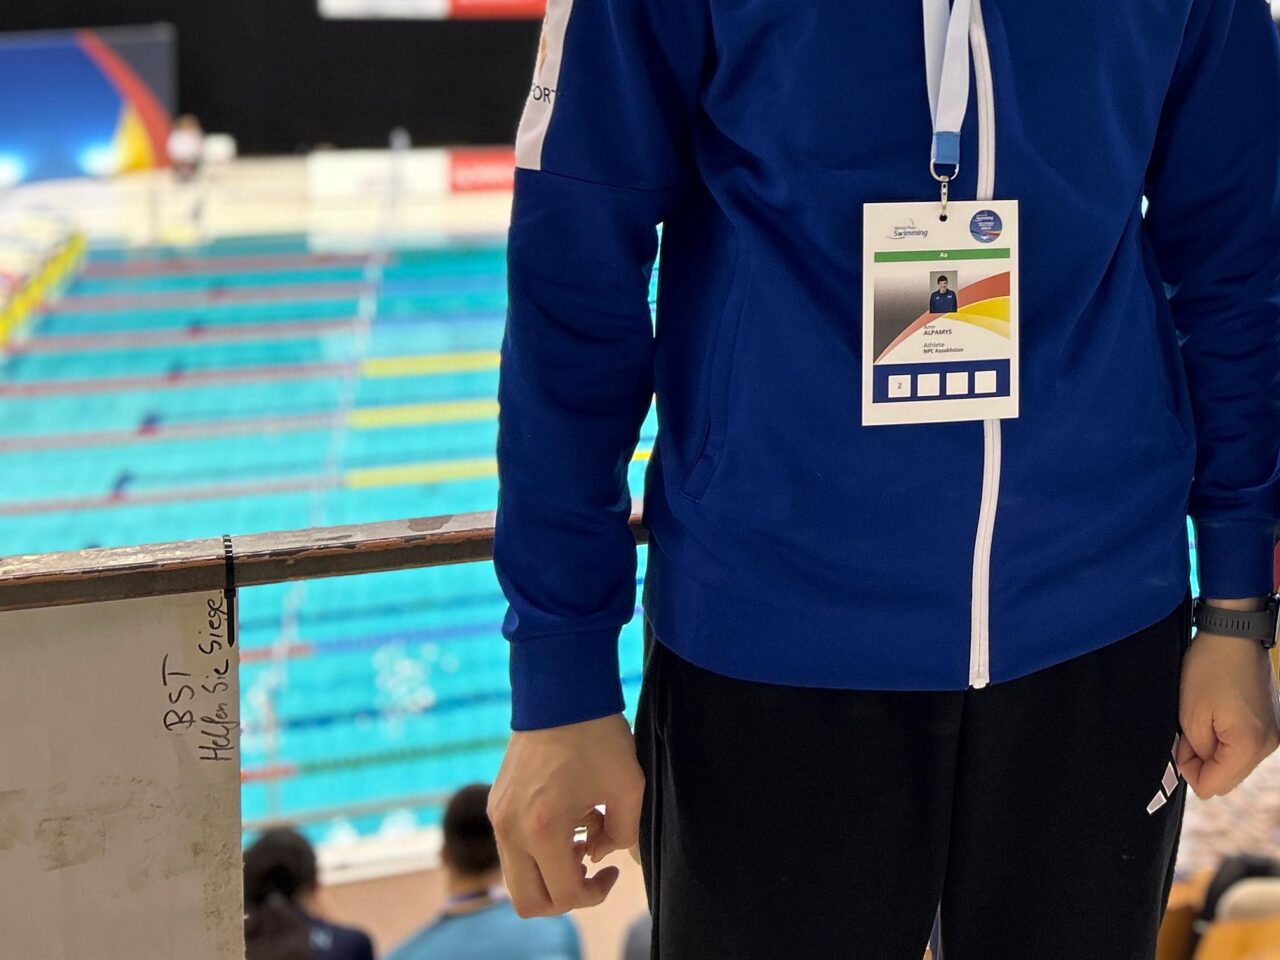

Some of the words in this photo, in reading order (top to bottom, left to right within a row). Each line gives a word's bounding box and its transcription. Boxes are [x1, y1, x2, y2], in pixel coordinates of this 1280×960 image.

[162, 653, 196, 731] BST
[201, 658, 229, 693] Sie
[198, 702, 241, 761] Helfen
